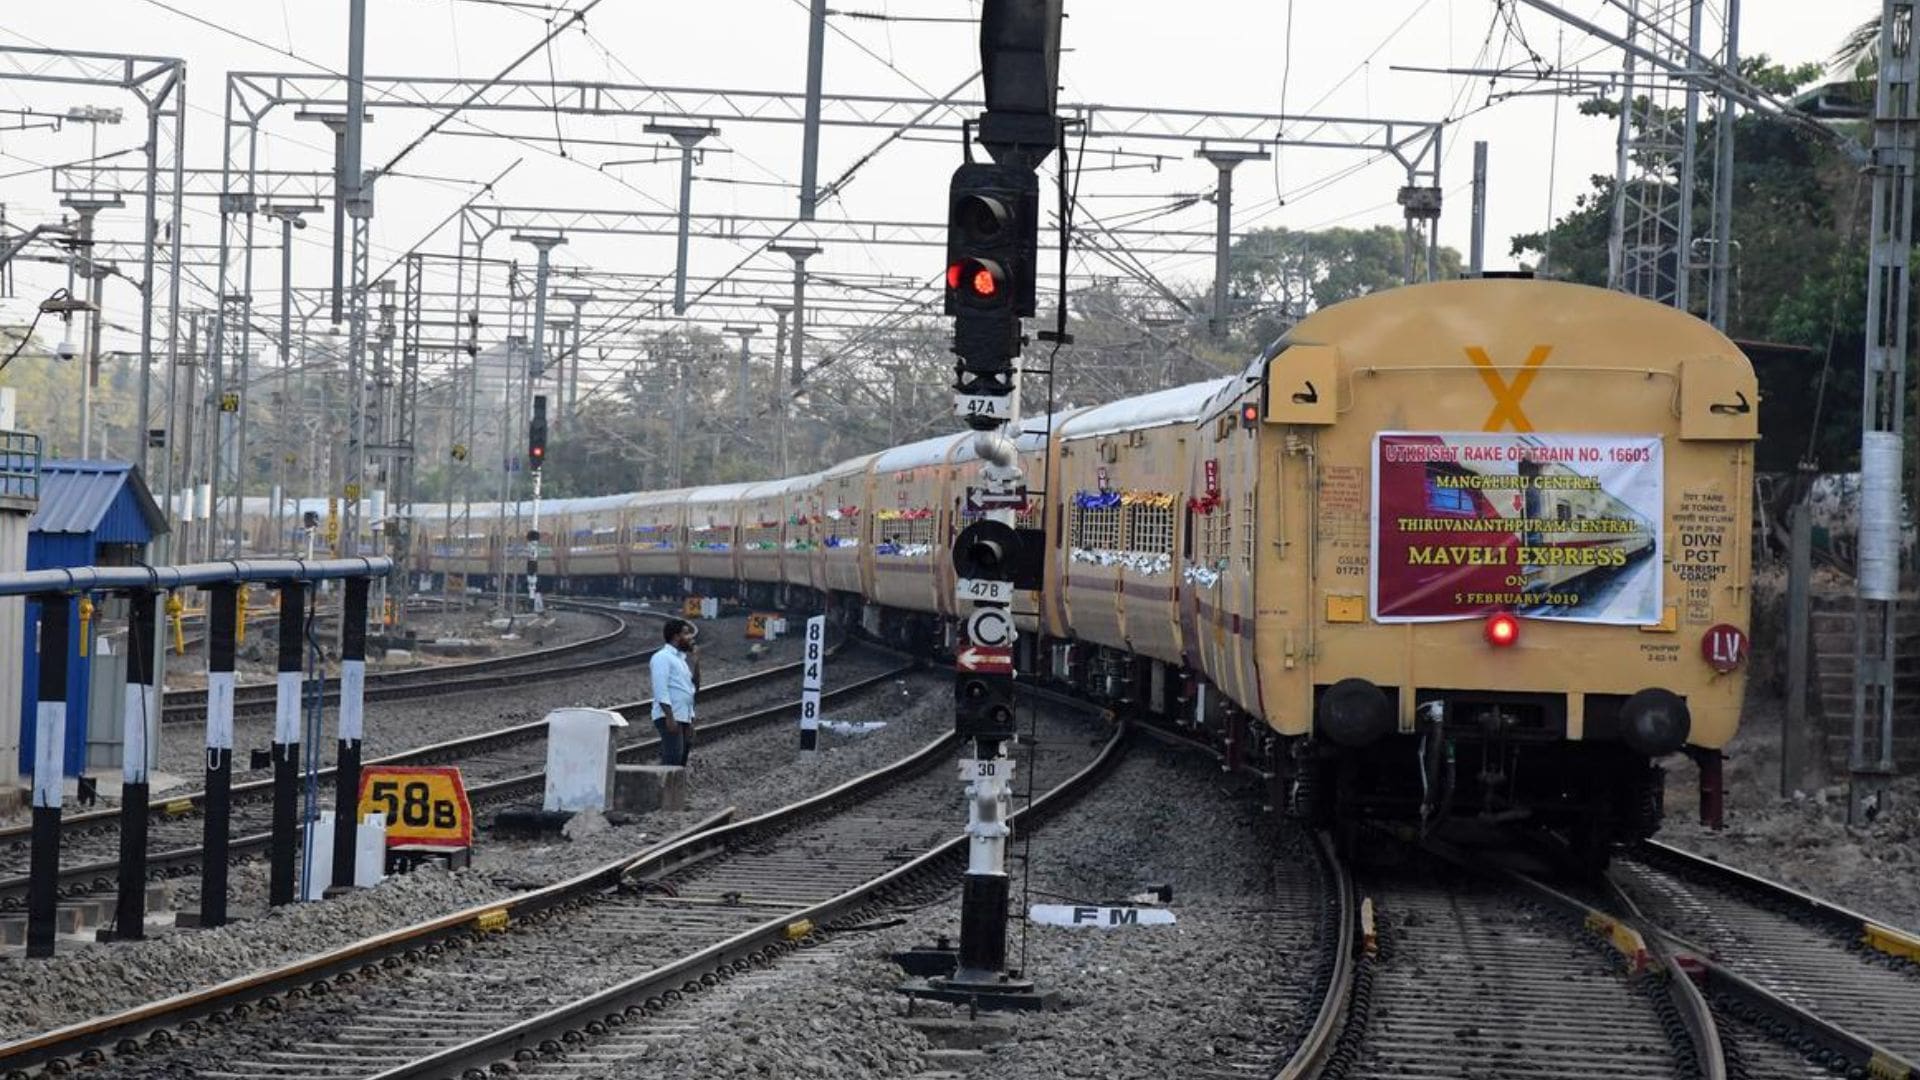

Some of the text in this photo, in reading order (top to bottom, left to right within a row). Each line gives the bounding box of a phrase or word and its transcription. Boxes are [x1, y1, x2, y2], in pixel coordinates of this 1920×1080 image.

[967, 399, 996, 414] 47A
[1385, 444, 1650, 462] UTKRISHT RAKE OF TRAIN NO. 16603
[1436, 474, 1602, 490] MANGALURU CENTRAL
[1398, 518, 1637, 533] THIRUVANANTHPURAM CENTRAL
[1682, 534, 1722, 547] DIVN
[1408, 546, 1627, 567] MAVELI EXPRESS
[1685, 549, 1720, 562] PGT
[1672, 563, 1728, 573] UTKRISHT
[1505, 575, 1528, 586] ON
[1680, 571, 1717, 582] COACH
[970, 583, 999, 597] 47B
[1455, 592, 1579, 605] 5 FEBRUARY 2019
[974, 611, 1006, 645] C
[807, 623, 820, 680] 884
[1713, 631, 1740, 662] LV
[804, 701, 815, 719] 8
[978, 763, 995, 776] 30
[372, 781, 457, 829] 58B
